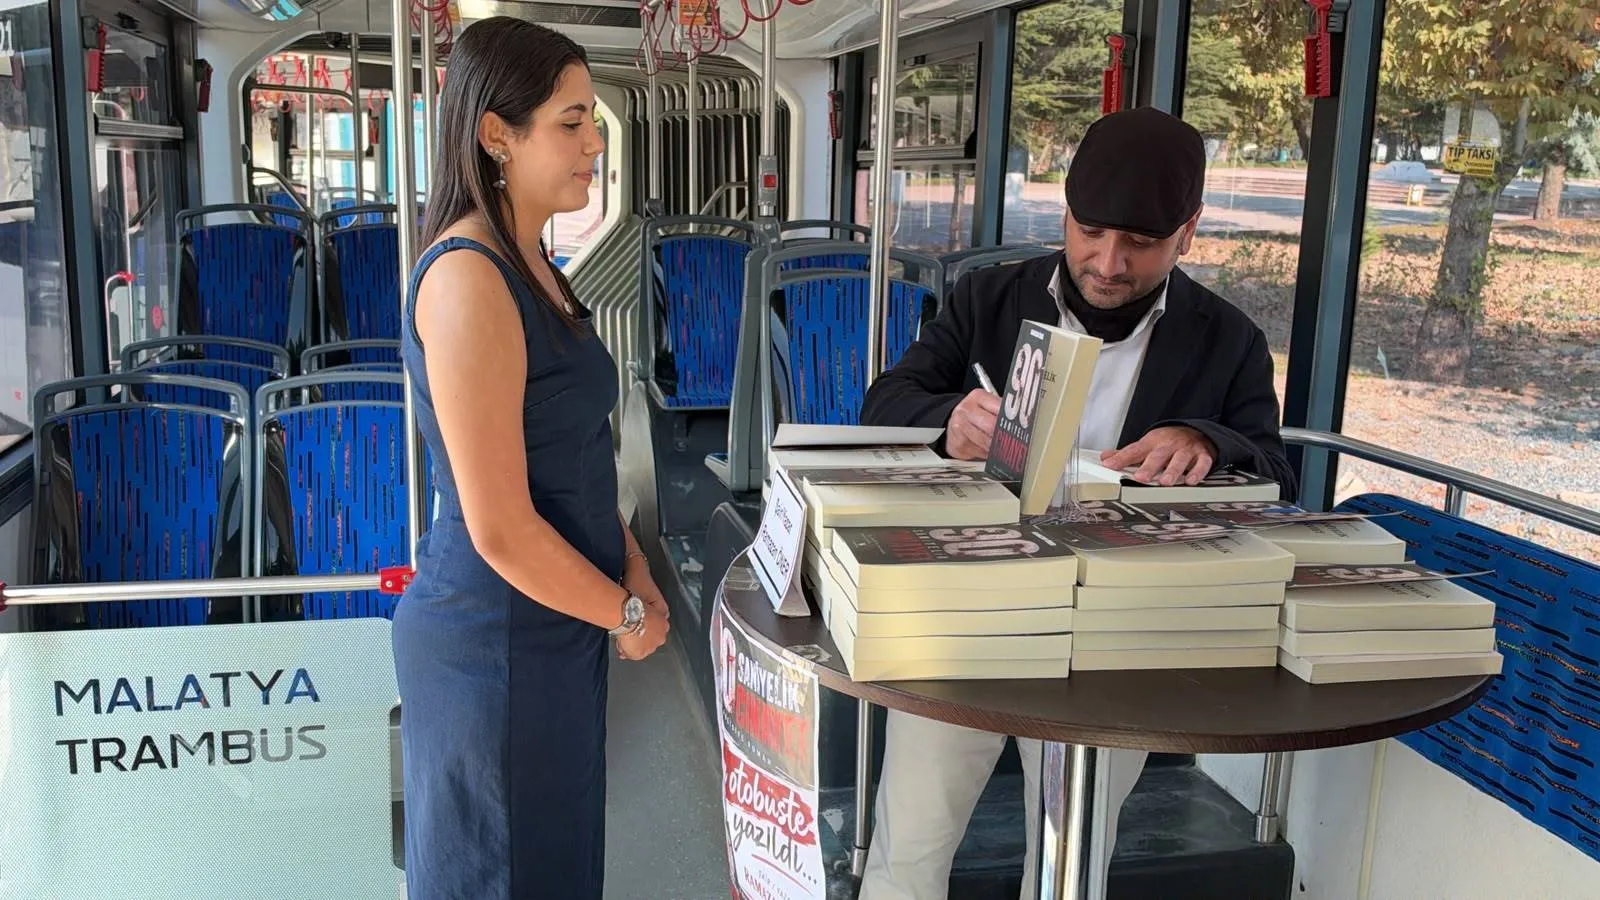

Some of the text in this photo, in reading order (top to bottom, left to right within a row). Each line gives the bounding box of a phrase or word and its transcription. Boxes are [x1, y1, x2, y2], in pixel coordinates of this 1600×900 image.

[54, 668, 321, 716] MALATYA
[55, 724, 328, 775] TRAMBUS
[728, 760, 810, 837] otobüste
